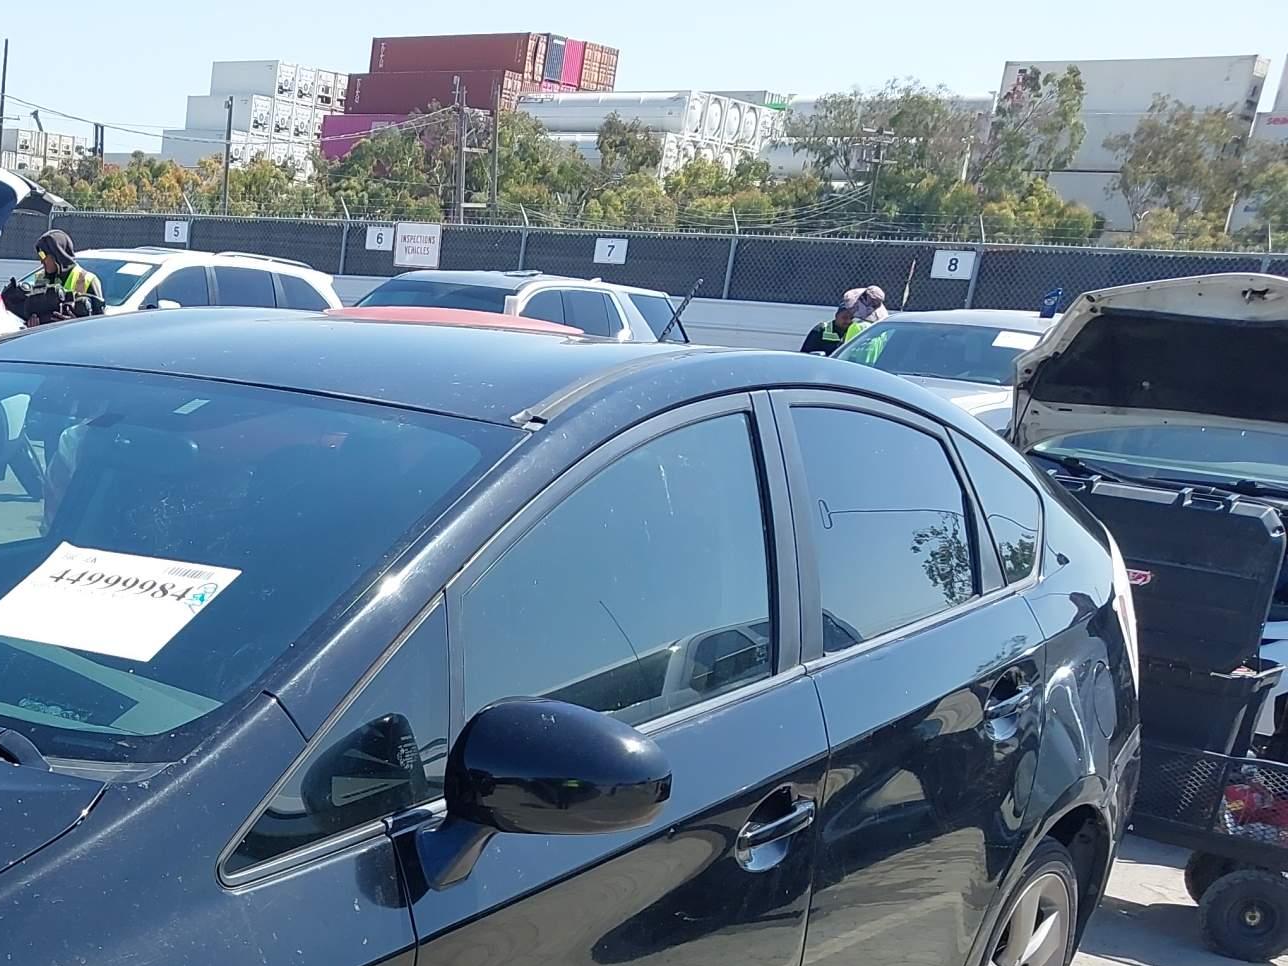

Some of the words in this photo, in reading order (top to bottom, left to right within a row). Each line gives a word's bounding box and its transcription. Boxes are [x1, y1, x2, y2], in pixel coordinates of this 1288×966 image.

[173, 226, 180, 237] 5
[376, 232, 384, 244] 6
[400, 234, 436, 245] INSPECTIONS
[404, 246, 430, 256] VEHICLES
[607, 244, 615, 257] 7
[947, 257, 959, 272] 8
[49, 568, 194, 602] 44999984
